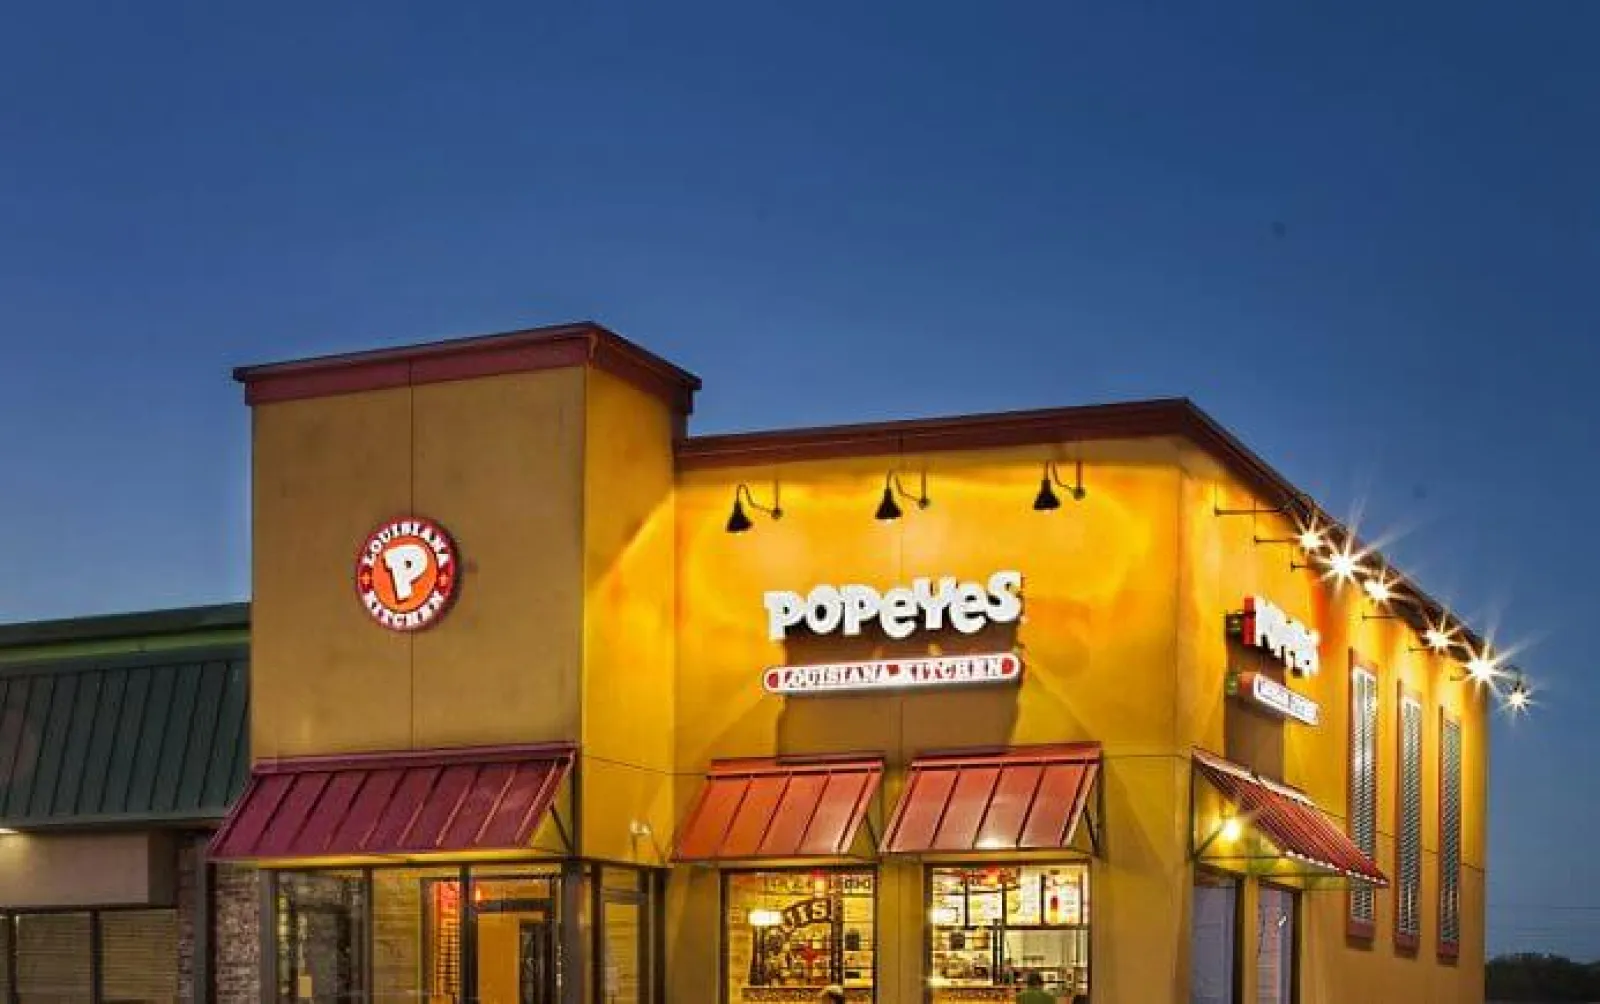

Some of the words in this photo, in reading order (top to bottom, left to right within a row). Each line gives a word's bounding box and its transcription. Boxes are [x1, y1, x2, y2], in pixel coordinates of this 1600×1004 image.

[362, 521, 450, 568] LOUISIANA
[384, 546, 428, 600] P
[363, 590, 444, 628] KITCHEN
[779, 664, 885, 689] LOUISIANA
[901, 657, 1000, 683] KITCHEN
